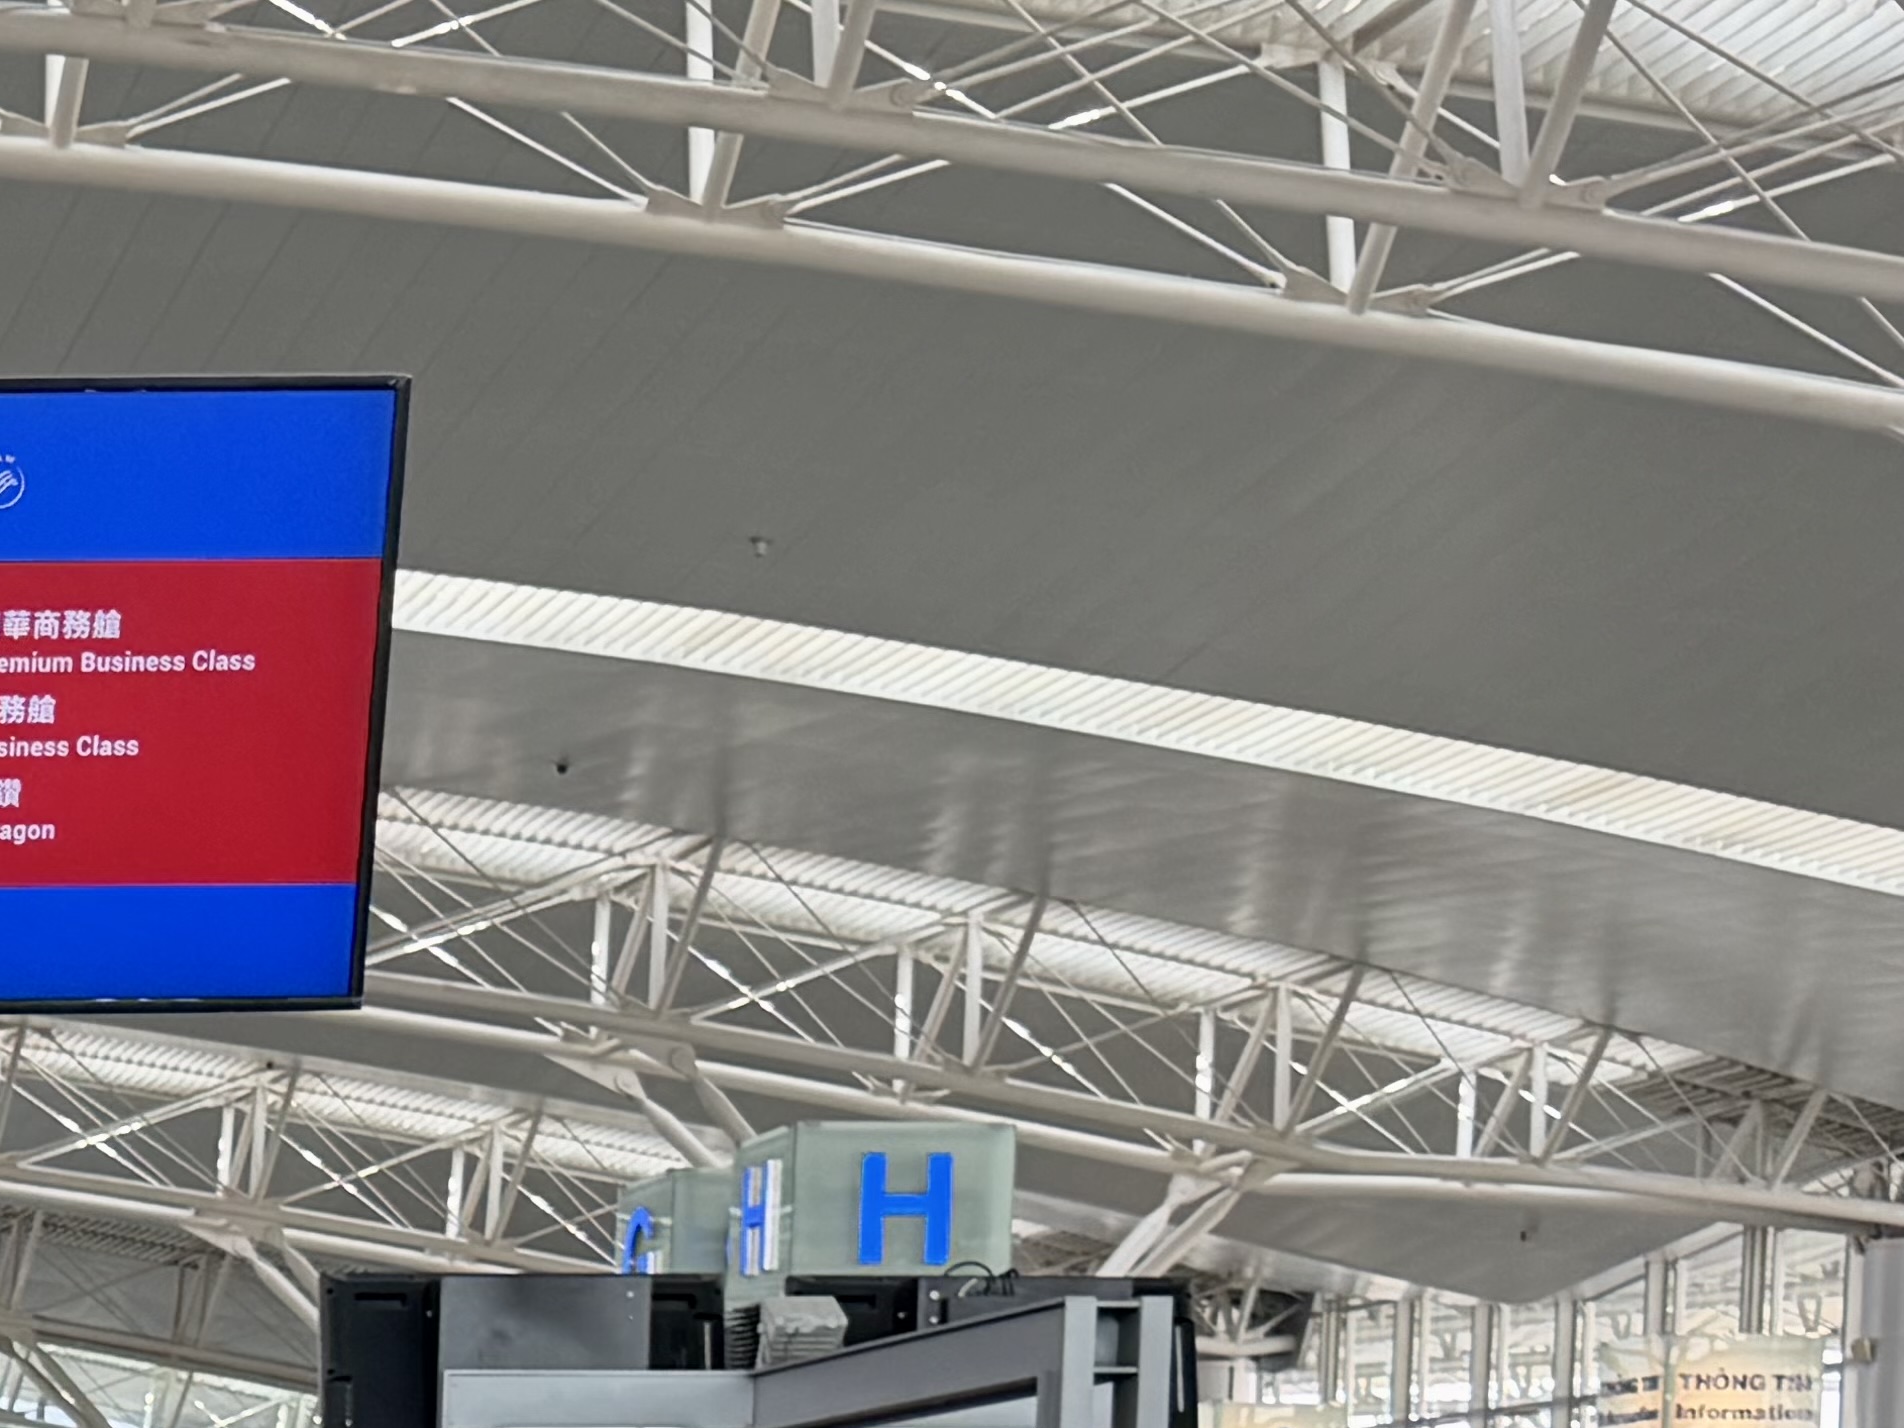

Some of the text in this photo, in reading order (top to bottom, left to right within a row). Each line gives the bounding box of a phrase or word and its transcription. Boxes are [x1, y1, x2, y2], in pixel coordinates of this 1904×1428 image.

[80, 651, 185, 672] Business
[191, 649, 256, 672] Class
[76, 735, 140, 757] Class
[741, 1159, 783, 1276] H
[858, 1152, 955, 1266] H
